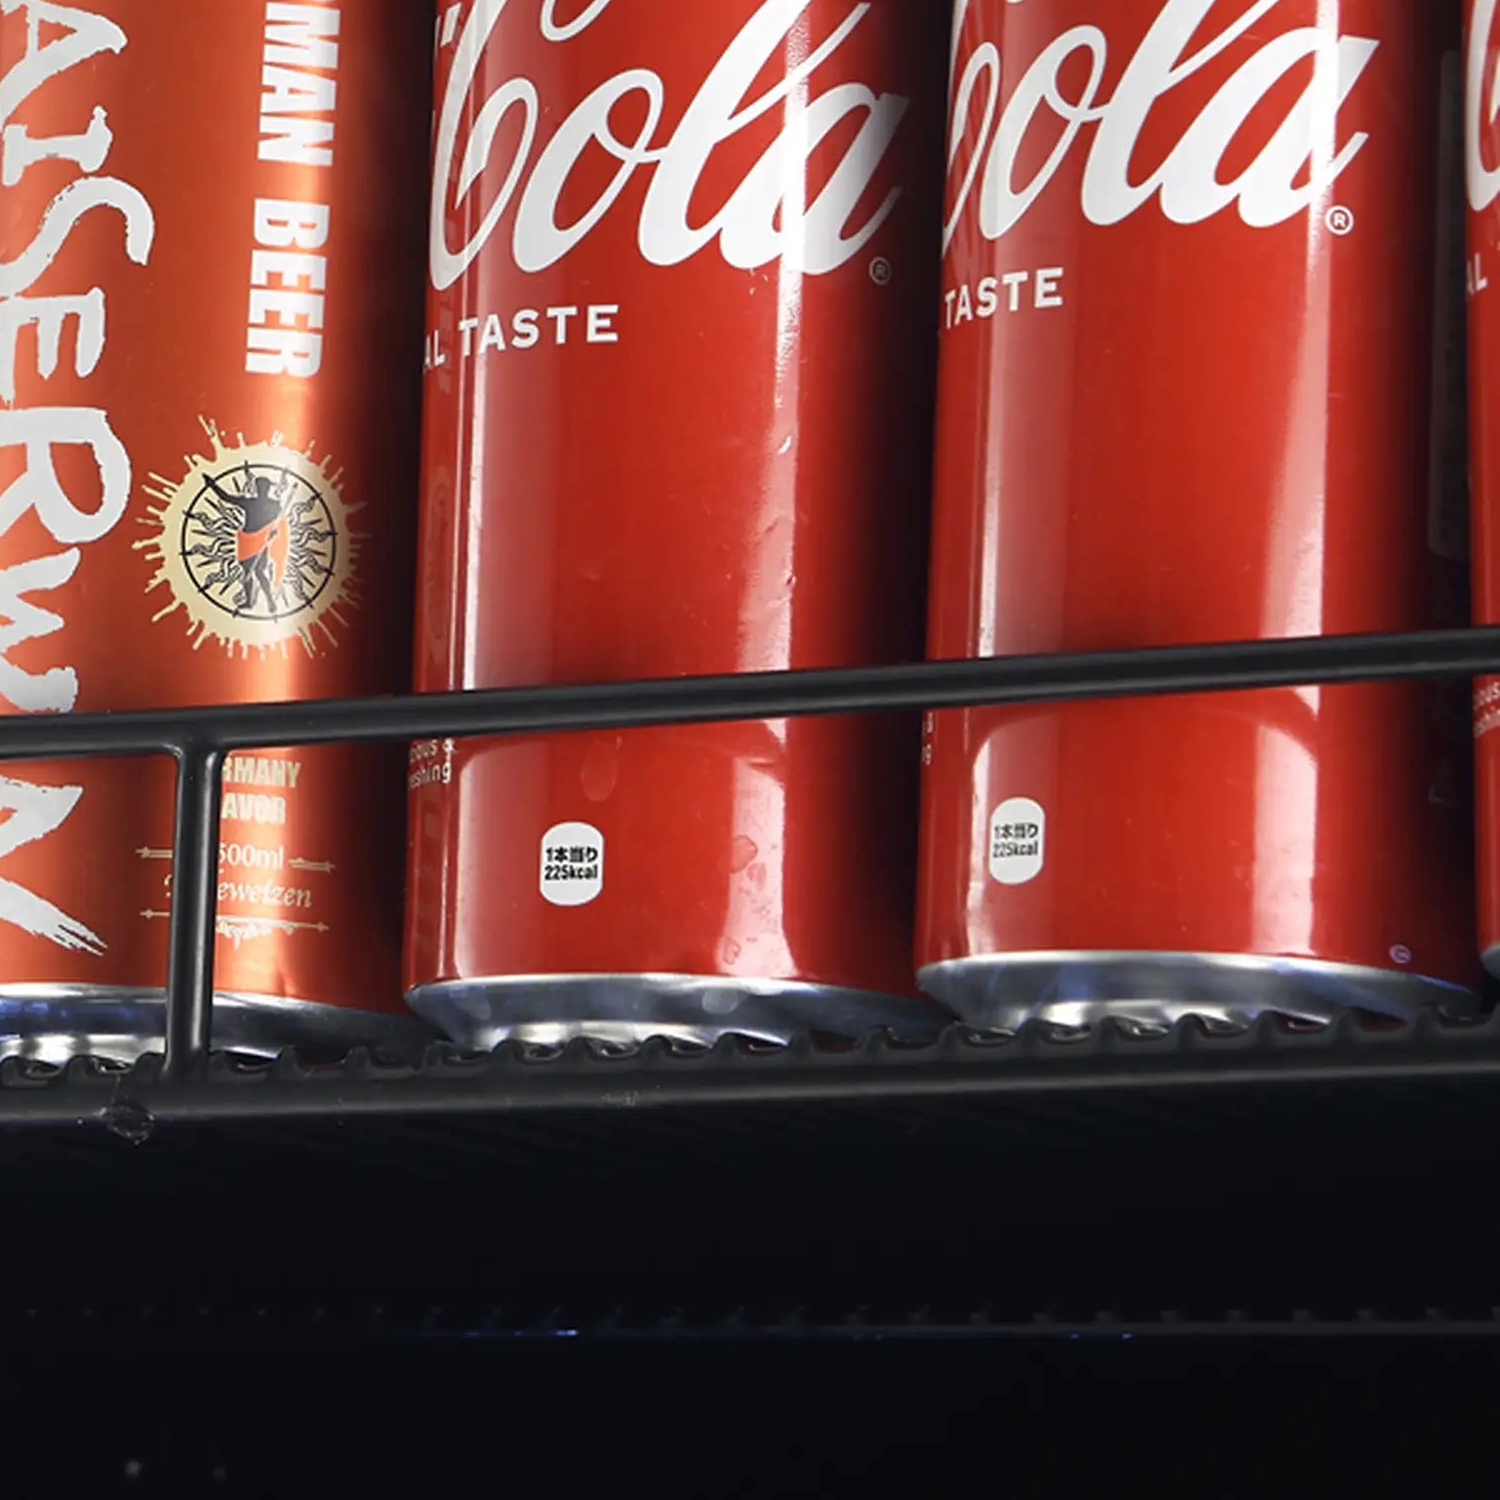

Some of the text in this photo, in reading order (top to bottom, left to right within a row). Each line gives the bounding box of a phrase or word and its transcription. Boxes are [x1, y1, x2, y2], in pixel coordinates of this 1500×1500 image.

[245, 197, 333, 377] BEER
[944, 267, 1064, 330] TASTE
[458, 303, 619, 358] TASTE
[222, 756, 301, 788] RMANY
[220, 792, 286, 825] AVOR
[219, 843, 284, 870] 500ml
